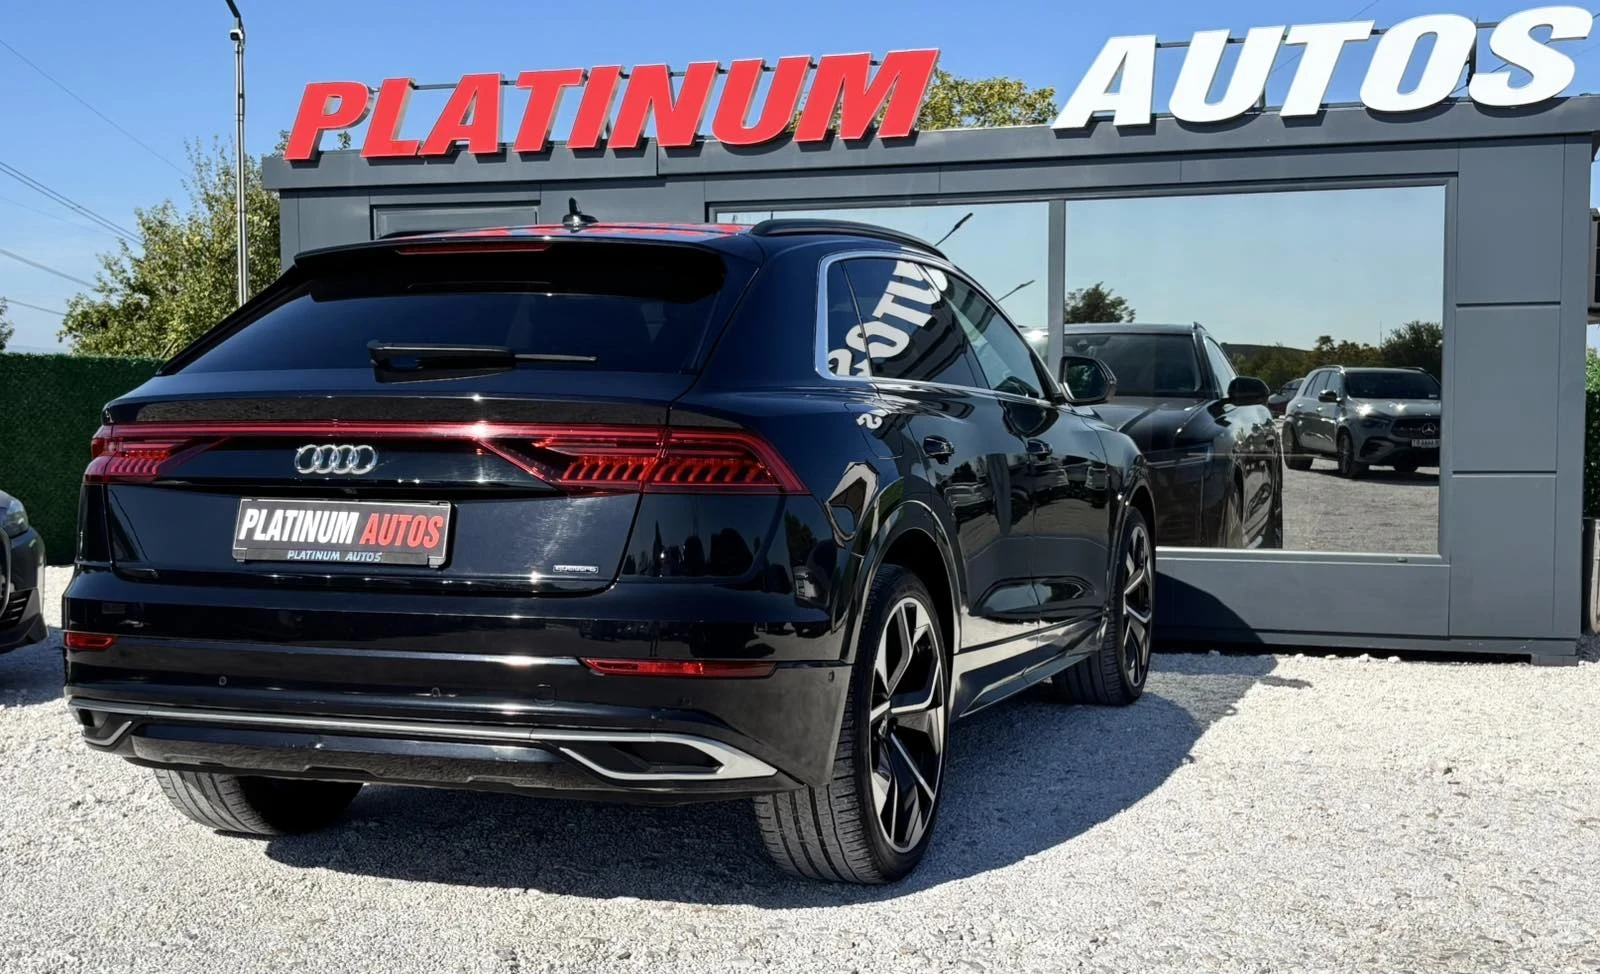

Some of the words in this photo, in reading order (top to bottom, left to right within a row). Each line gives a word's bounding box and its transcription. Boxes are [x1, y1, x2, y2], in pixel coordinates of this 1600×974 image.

[284, 48, 940, 160] PLATINUM
[1050, 6, 1594, 131] AUTOS
[239, 508, 360, 544] PLATINUM
[359, 512, 444, 549] AUTOS
[287, 550, 340, 561] PLATINUM
[346, 551, 382, 562] AUTOS
